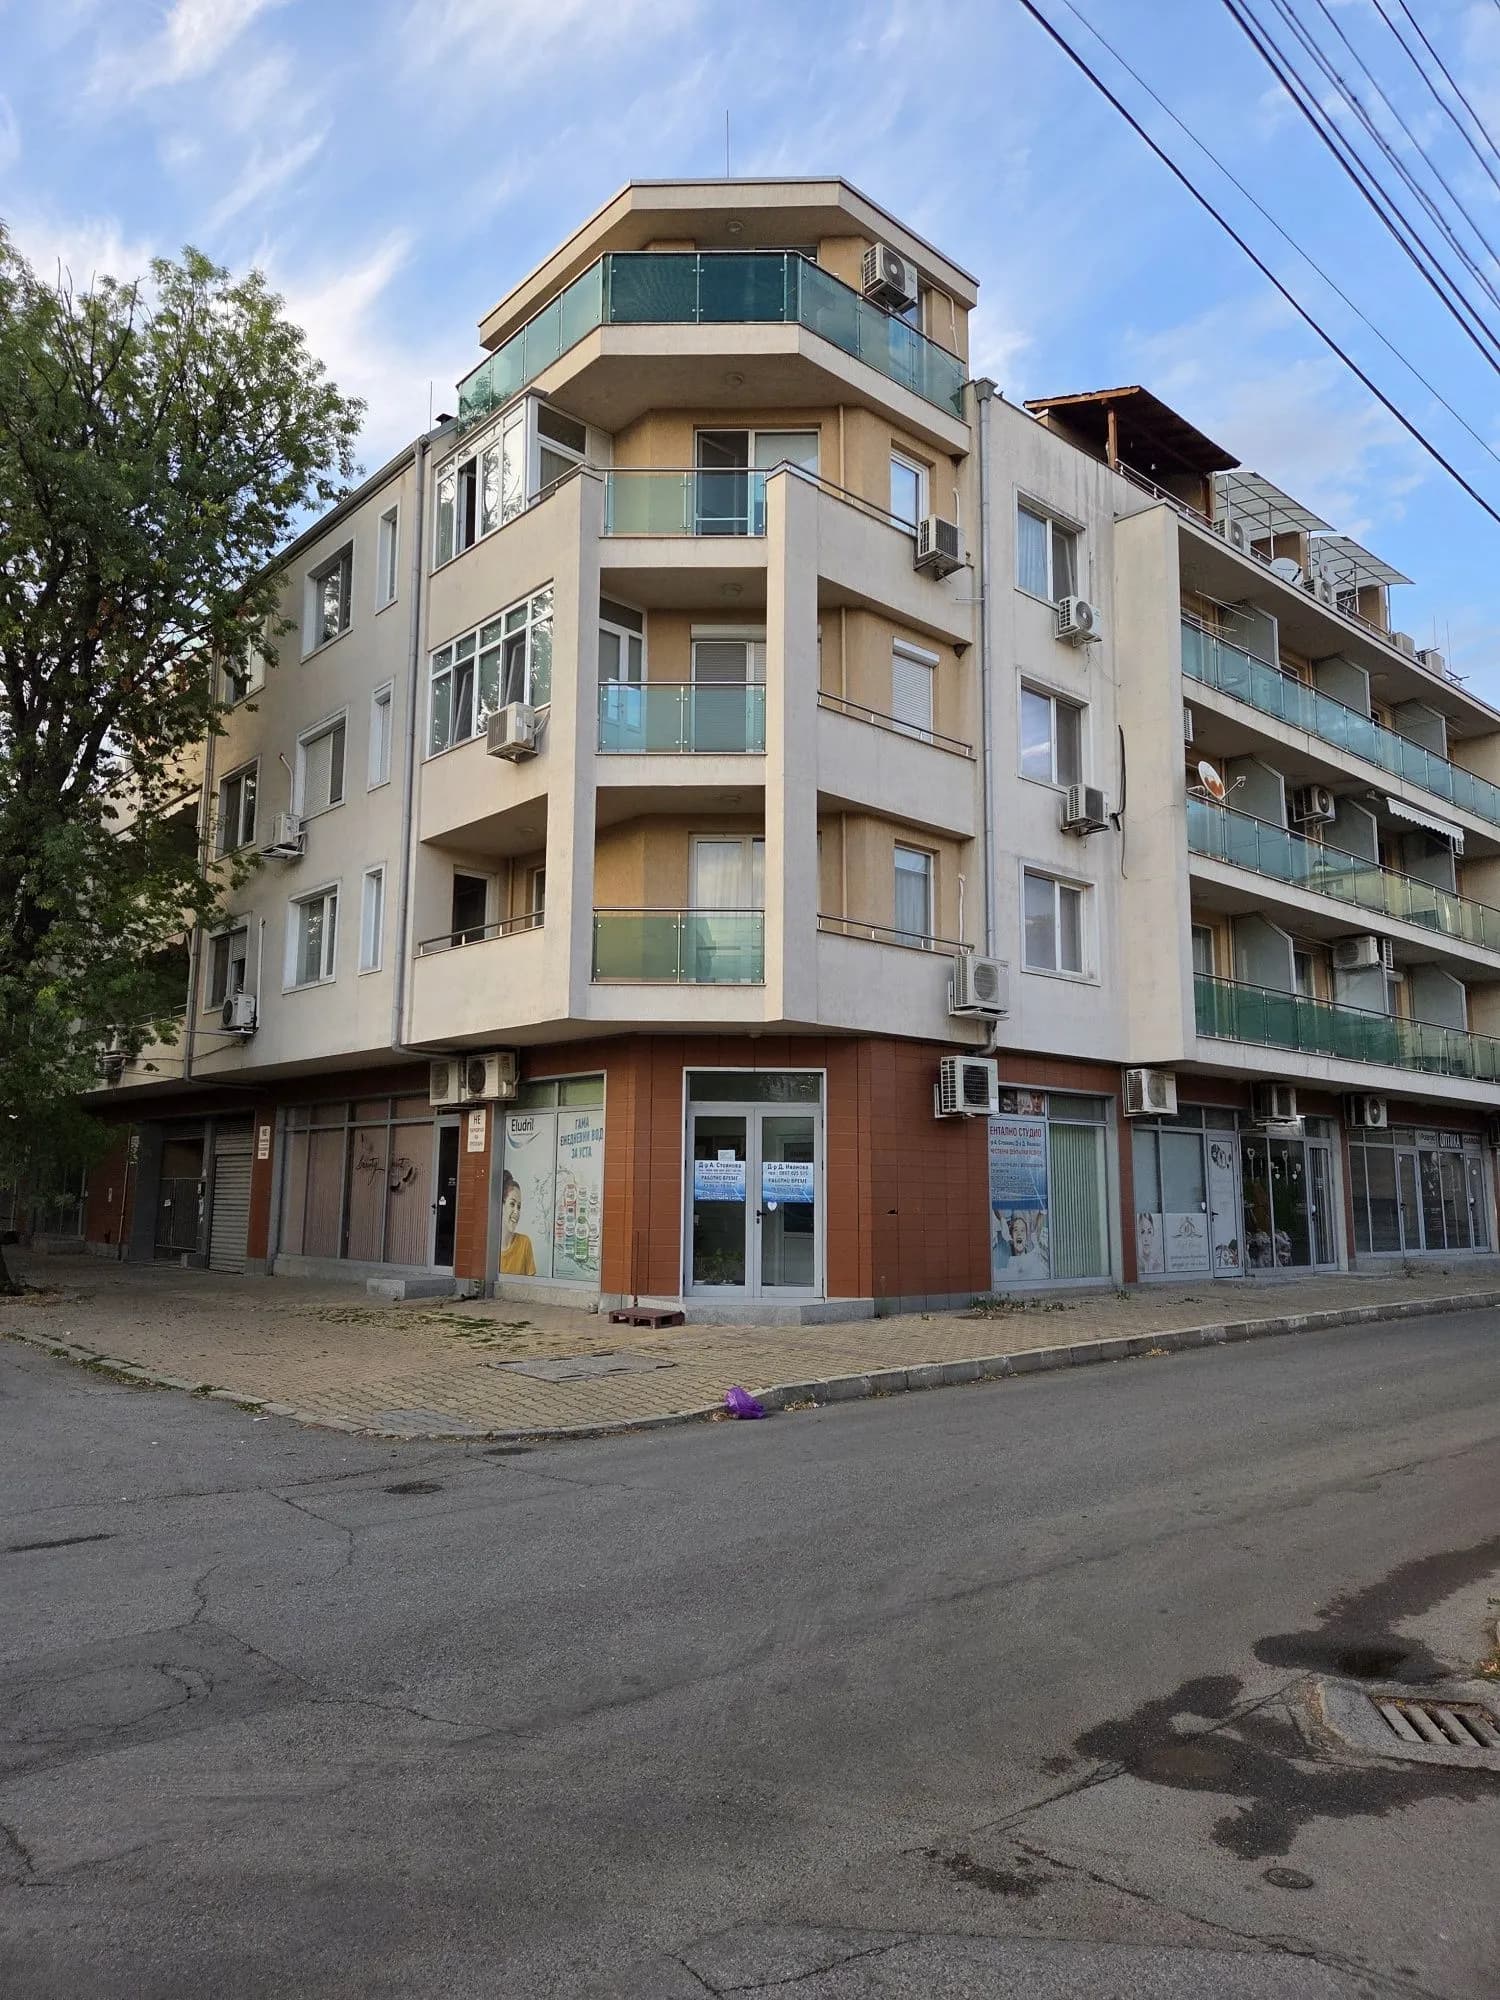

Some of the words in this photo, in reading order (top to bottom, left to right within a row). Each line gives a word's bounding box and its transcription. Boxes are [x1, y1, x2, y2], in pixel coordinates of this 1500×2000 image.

[473, 1114, 481, 1125] НЕ
[511, 1118, 534, 1132] Eludril
[591, 1128, 604, 1142] ВОД
[990, 1126, 1017, 1137] ЕНТАЛНО
[1018, 1127, 1042, 1138] СТУДИО
